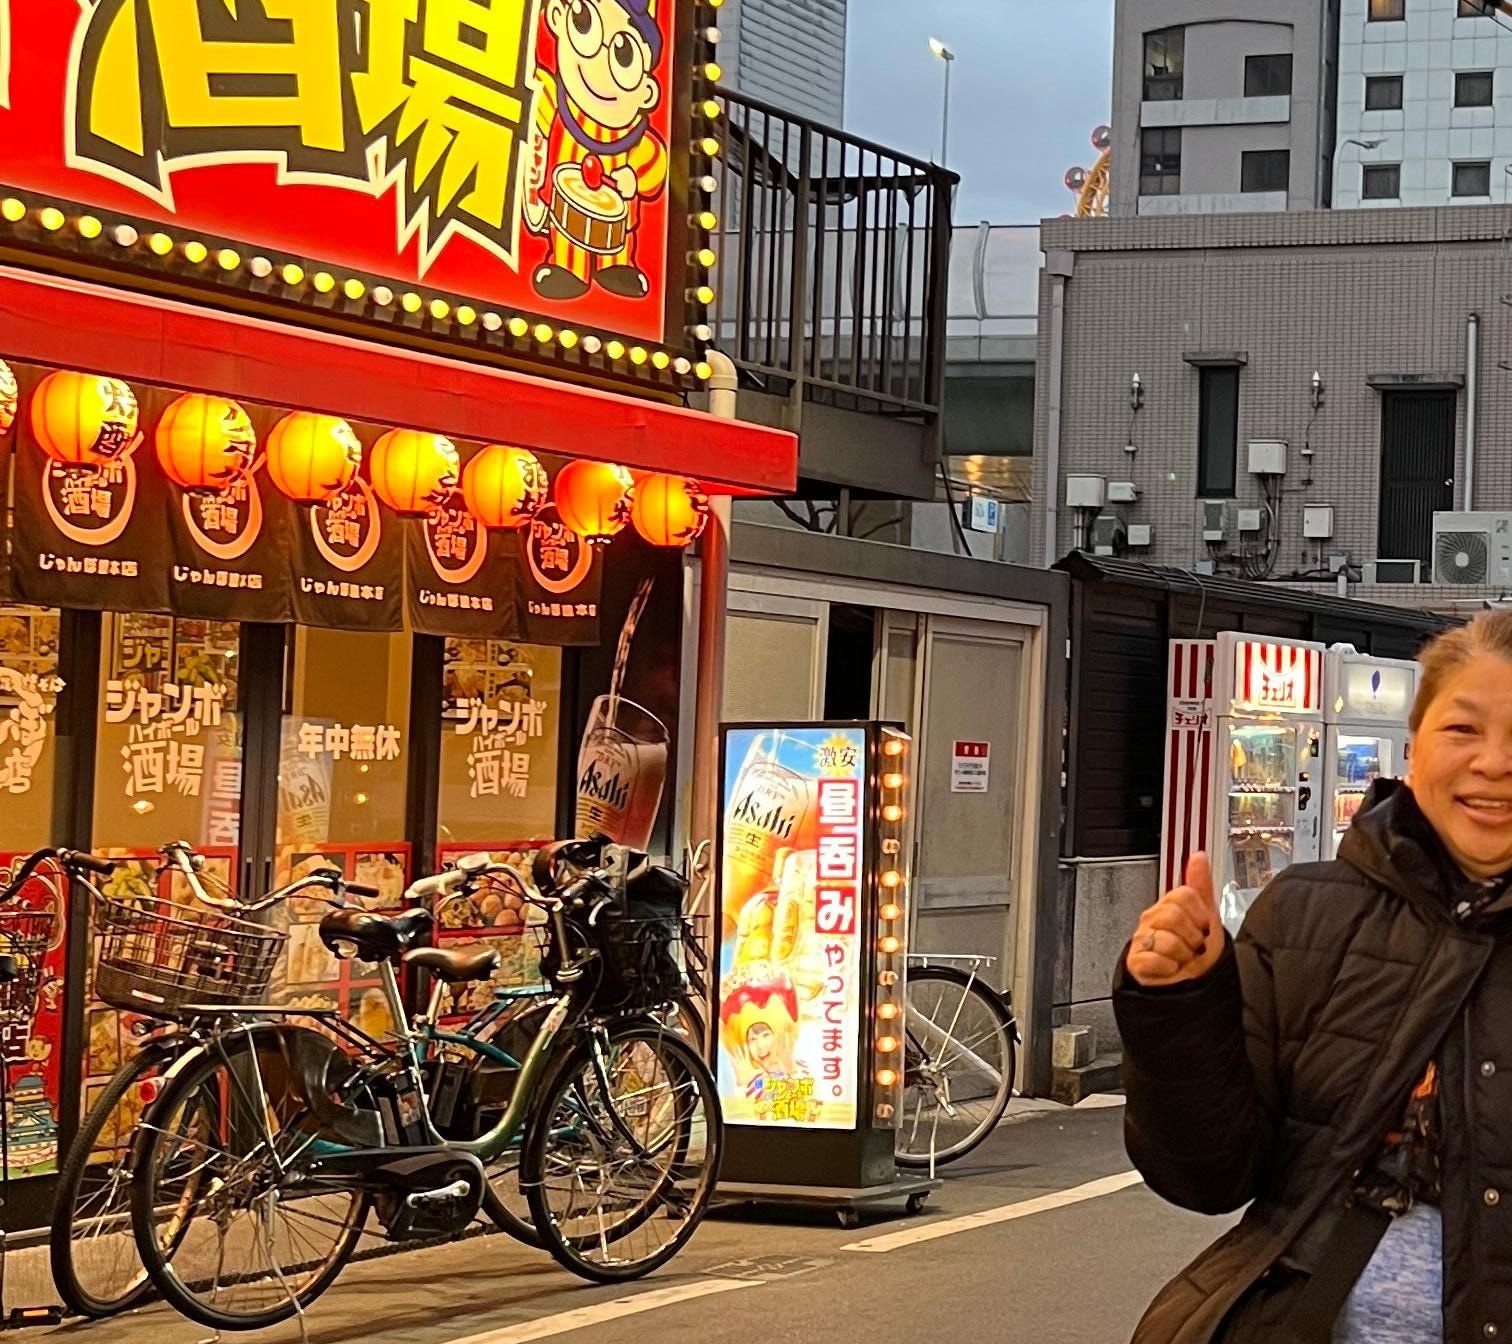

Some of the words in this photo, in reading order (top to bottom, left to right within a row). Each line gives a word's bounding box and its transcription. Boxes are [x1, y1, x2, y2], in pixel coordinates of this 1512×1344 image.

[105, 678, 228, 726] ジャンボ
[455, 697, 548, 737] ジャンボ
[298, 722, 401, 761] 年中無休
[819, 746, 857, 768] 激安
[120, 740, 205, 797] 酒場
[466, 749, 530, 798] 酒場
[579, 759, 630, 812] Asahi
[733, 790, 796, 840] Asahi
[745, 832, 762, 848] 生
